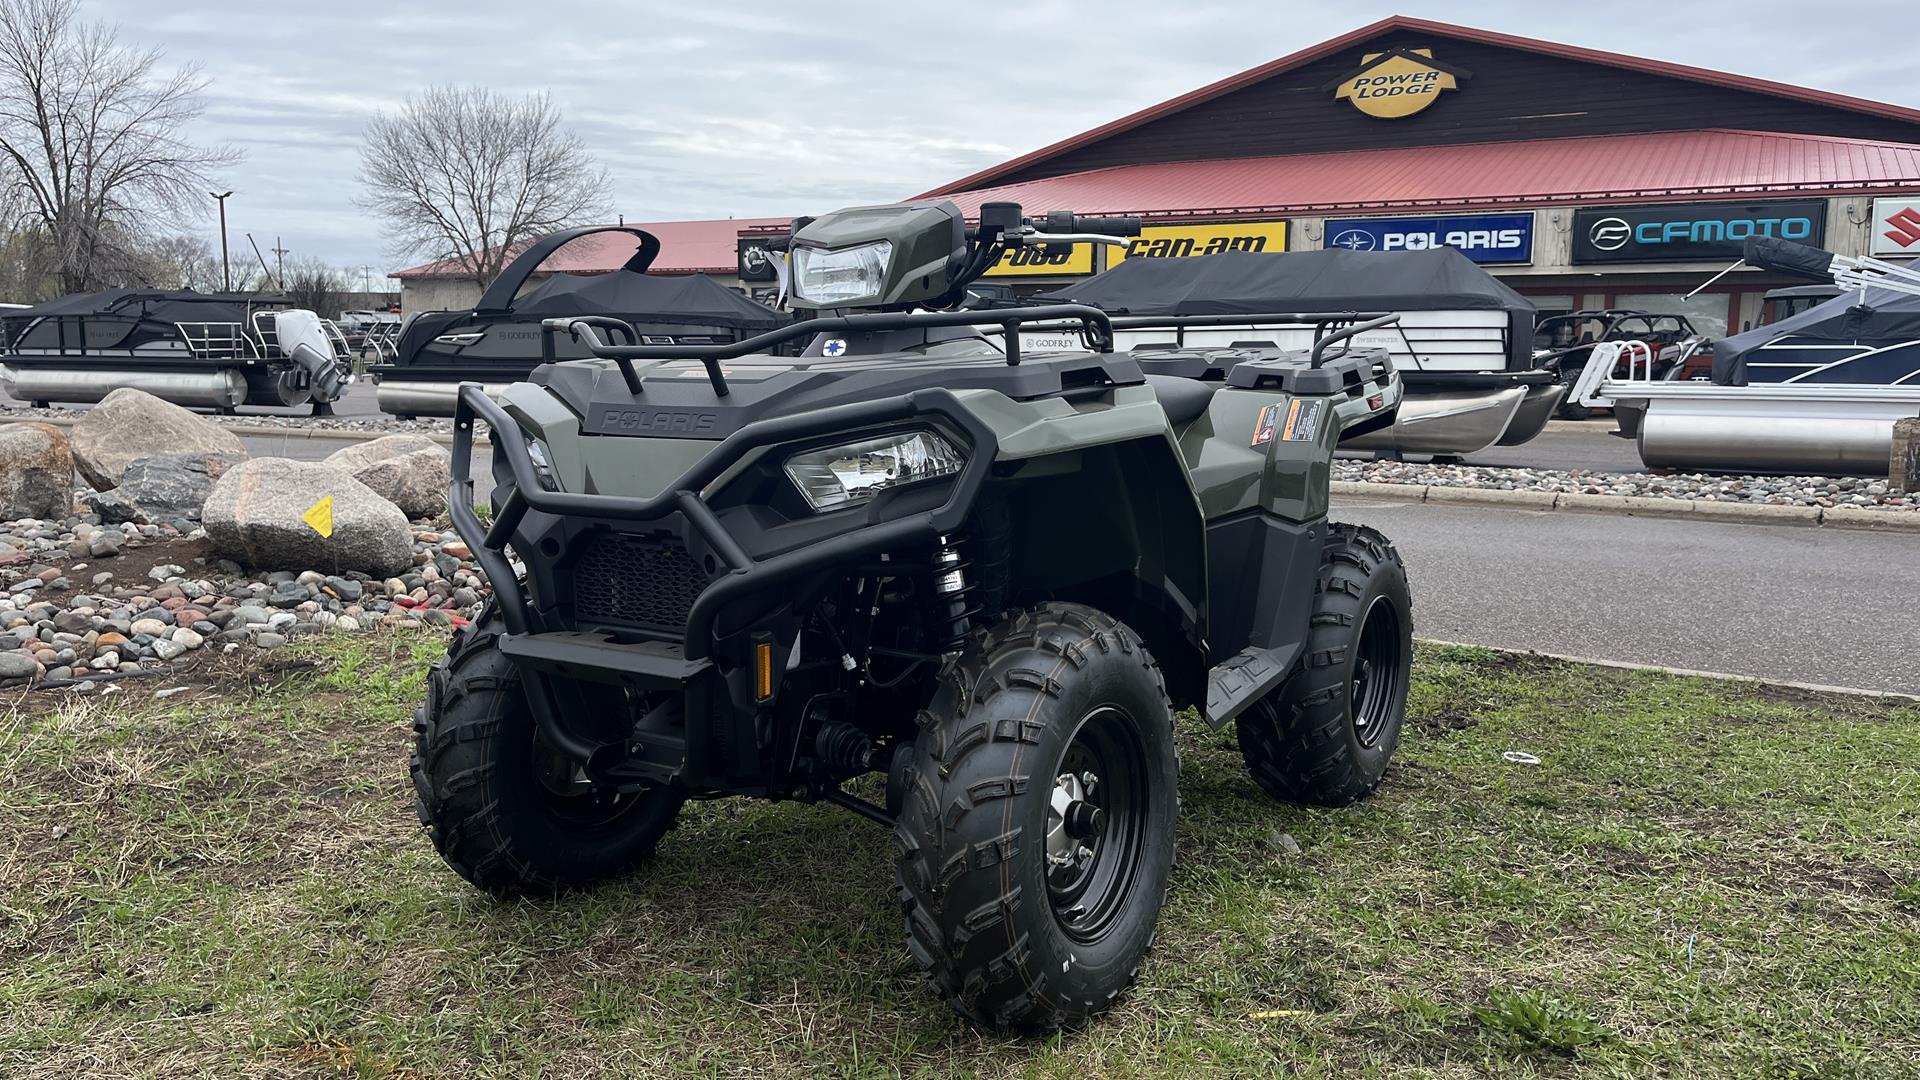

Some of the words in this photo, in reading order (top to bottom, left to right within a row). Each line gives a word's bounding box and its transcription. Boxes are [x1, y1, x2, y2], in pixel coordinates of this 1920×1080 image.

[1353, 71, 1440, 90] POWER
[1357, 83, 1436, 99] LODGE
[1383, 229, 1521, 251] POLARIS
[1635, 217, 1811, 244] CFMOTO
[1035, 339, 1074, 348] GODFREY
[601, 409, 718, 433] POLARIS
